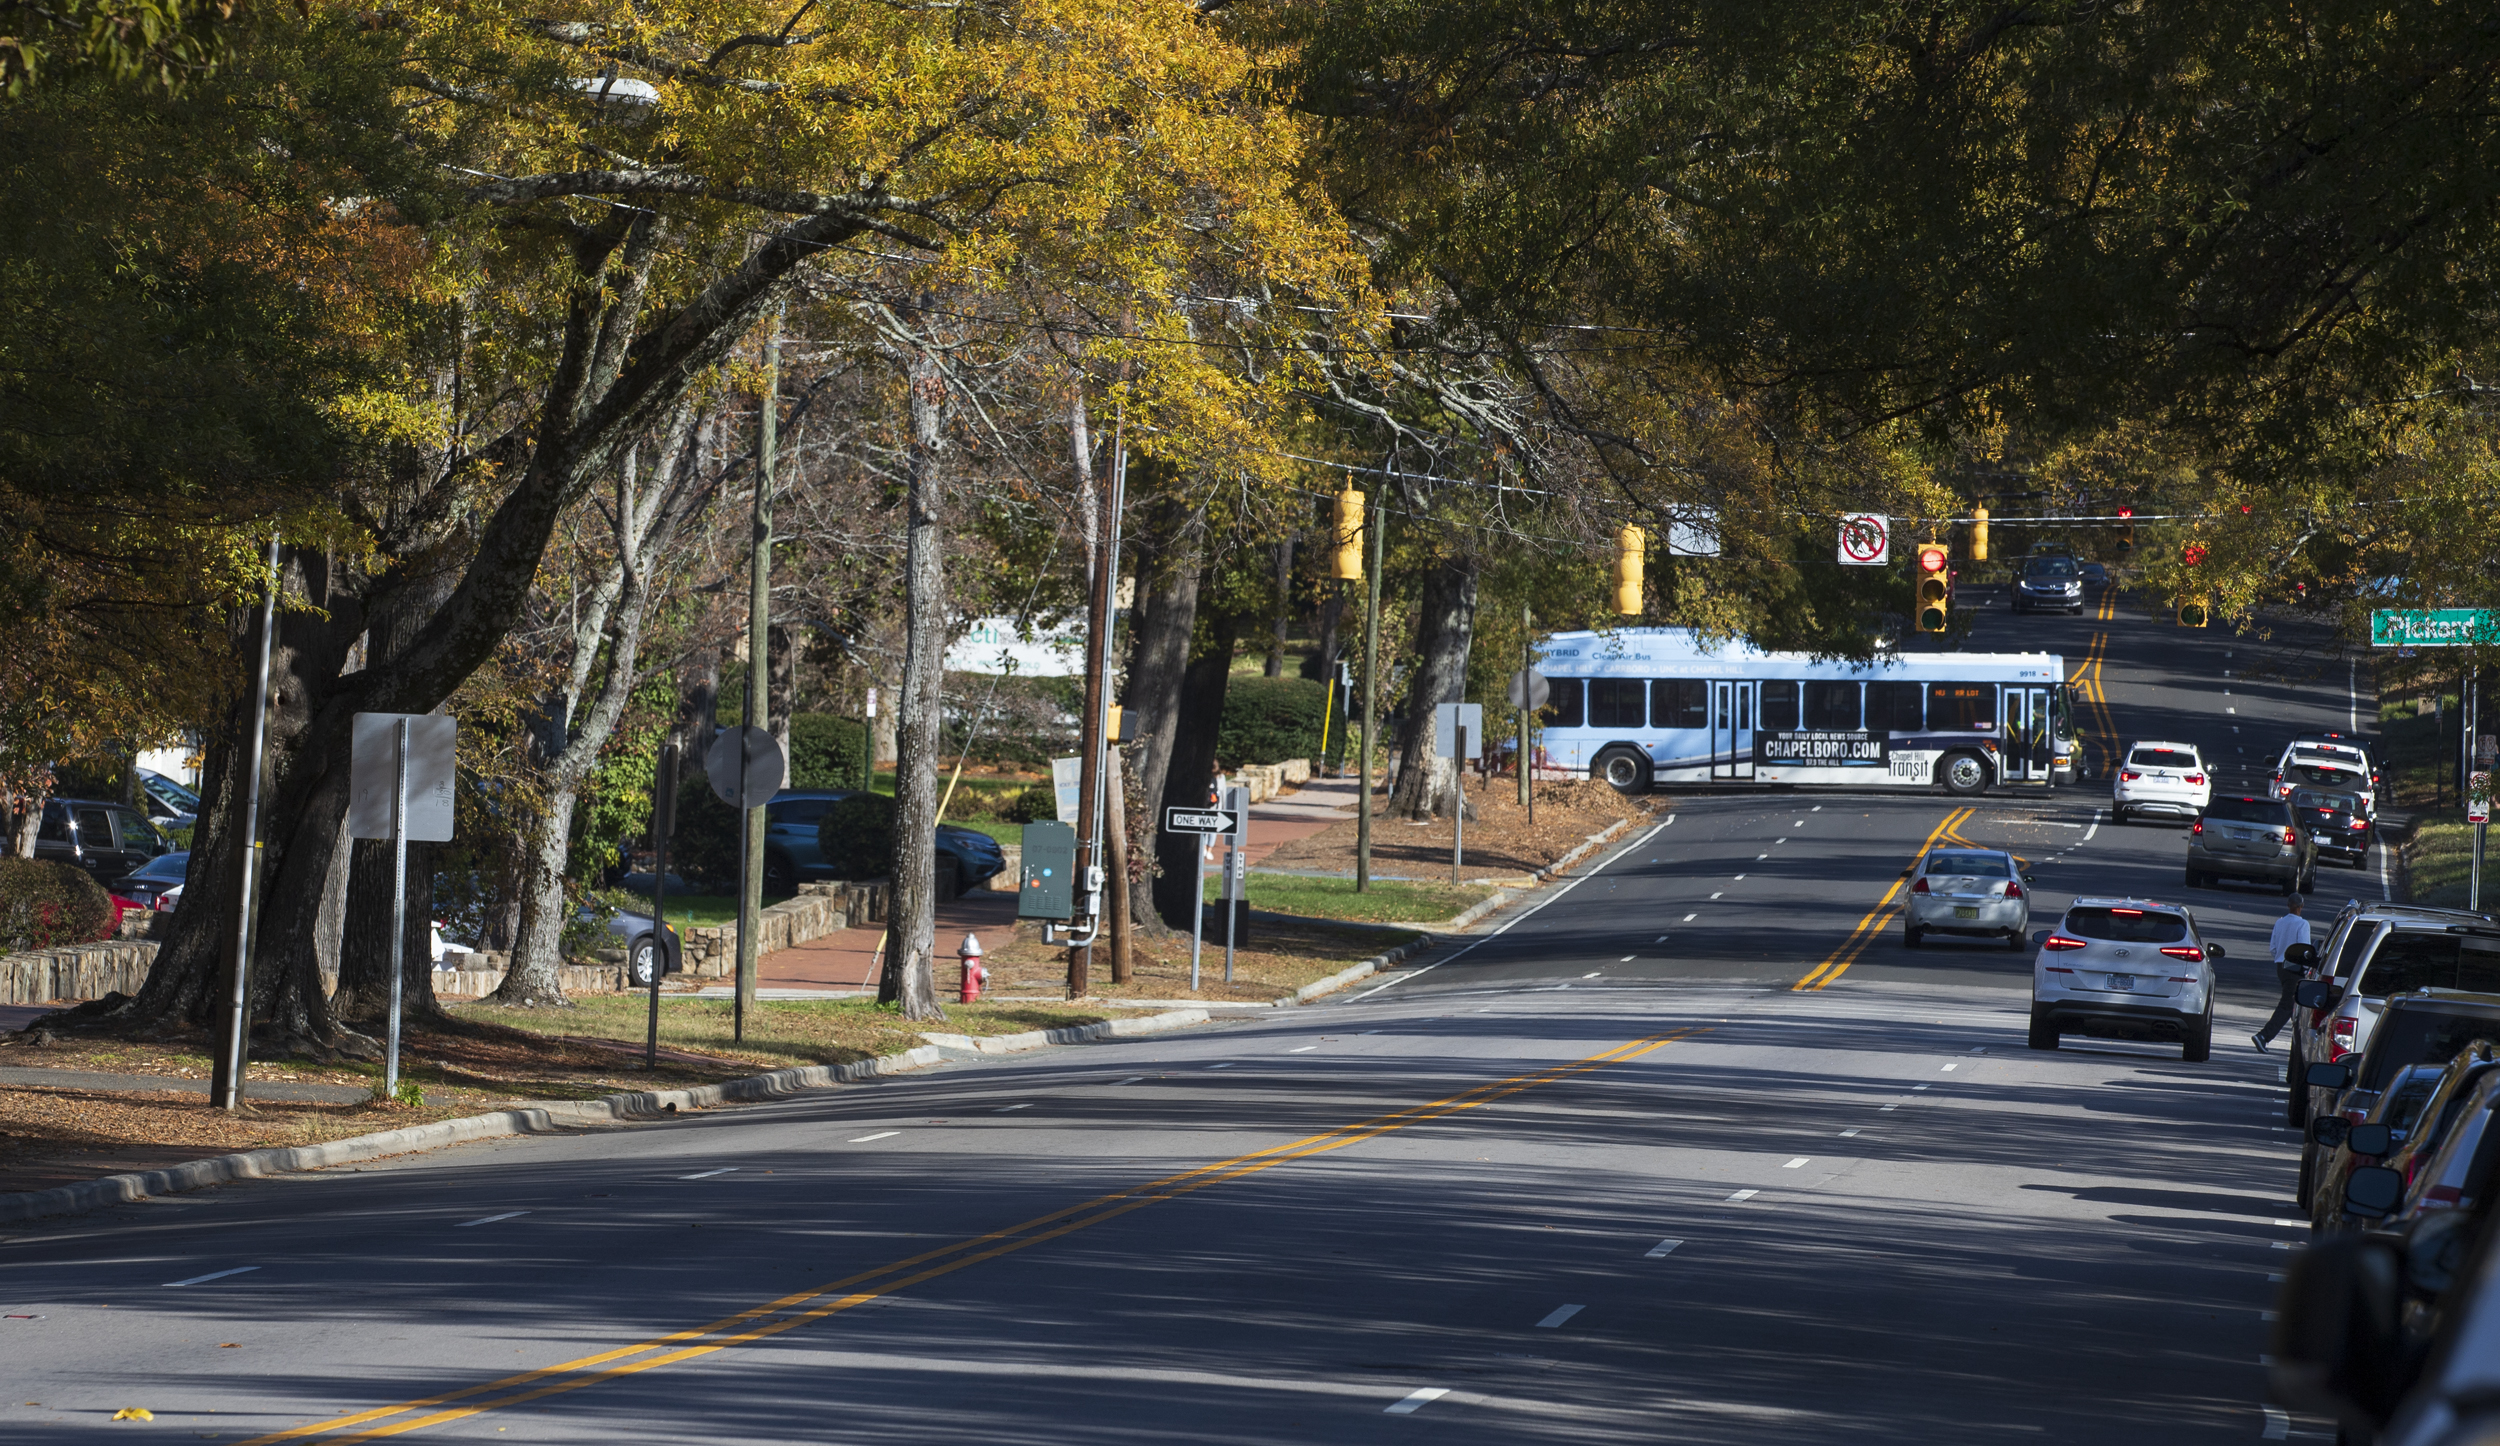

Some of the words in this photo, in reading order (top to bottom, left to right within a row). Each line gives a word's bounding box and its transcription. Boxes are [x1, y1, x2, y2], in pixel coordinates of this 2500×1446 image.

[2388, 616, 2475, 639] Pickard
[1541, 665, 1573, 673] CHAPEL
[1576, 665, 1594, 673] HILL
[1604, 665, 1650, 674] CARRBORO
[1659, 666, 1677, 674] UNC
[1690, 666, 1723, 675] CHAPEL
[1725, 666, 1744, 675] HILL
[1778, 732, 1793, 740] YOUR
[1794, 732, 1810, 740] DAILY
[1811, 732, 1829, 741] LOCAL
[1830, 733, 1845, 741] NEWS
[1846, 733, 1868, 741] SOURCE
[1765, 740, 1881, 759] CHAPELBORO.COM
[1891, 751, 1913, 762] Chapel
[1914, 751, 1925, 760] Hill
[1817, 758, 1828, 767] THE
[1829, 759, 1840, 767] HILL
[1176, 816, 1195, 826] ONE
[1198, 817, 1217, 826] WAY
